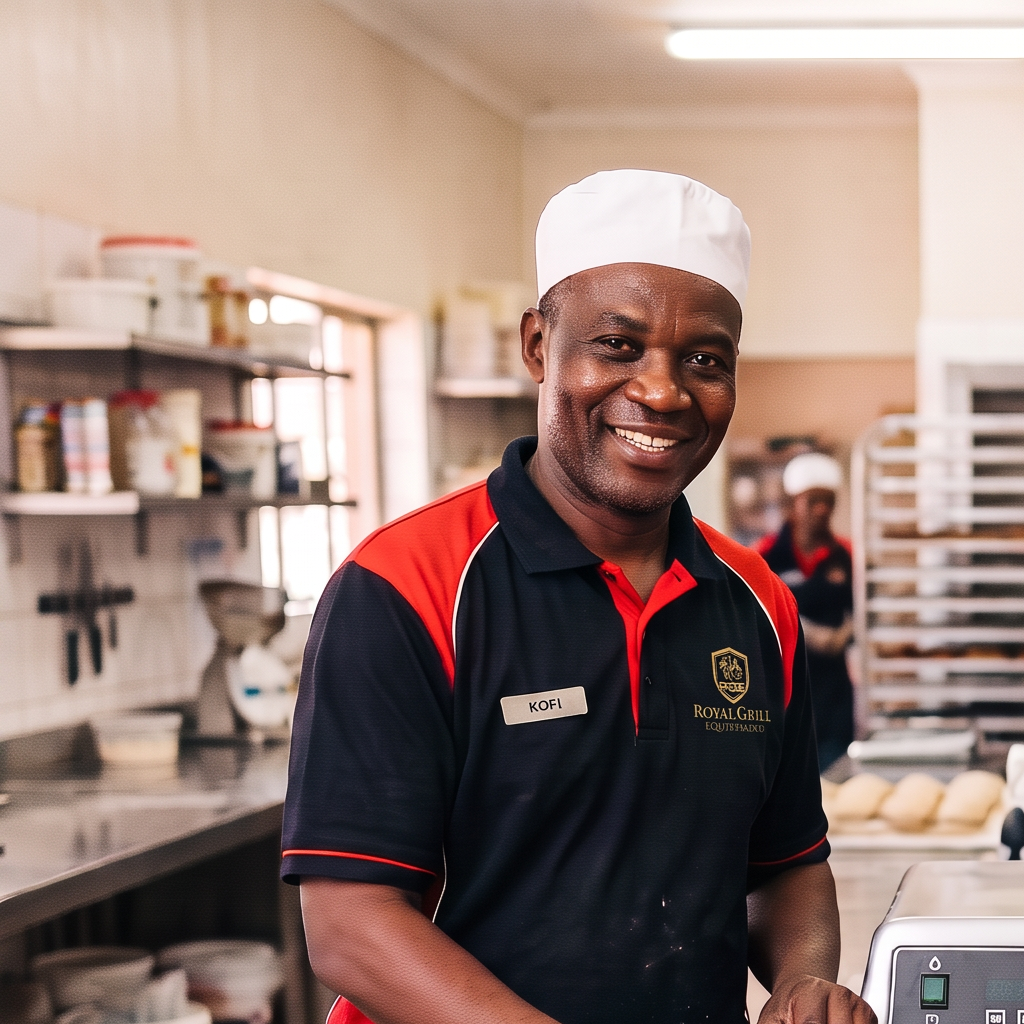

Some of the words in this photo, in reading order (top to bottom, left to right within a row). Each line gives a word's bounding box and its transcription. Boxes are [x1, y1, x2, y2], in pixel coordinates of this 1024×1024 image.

[528, 698, 562, 713] KOFI
[693, 704, 737, 720] ROYAL
[736, 706, 772, 722] GRILL
